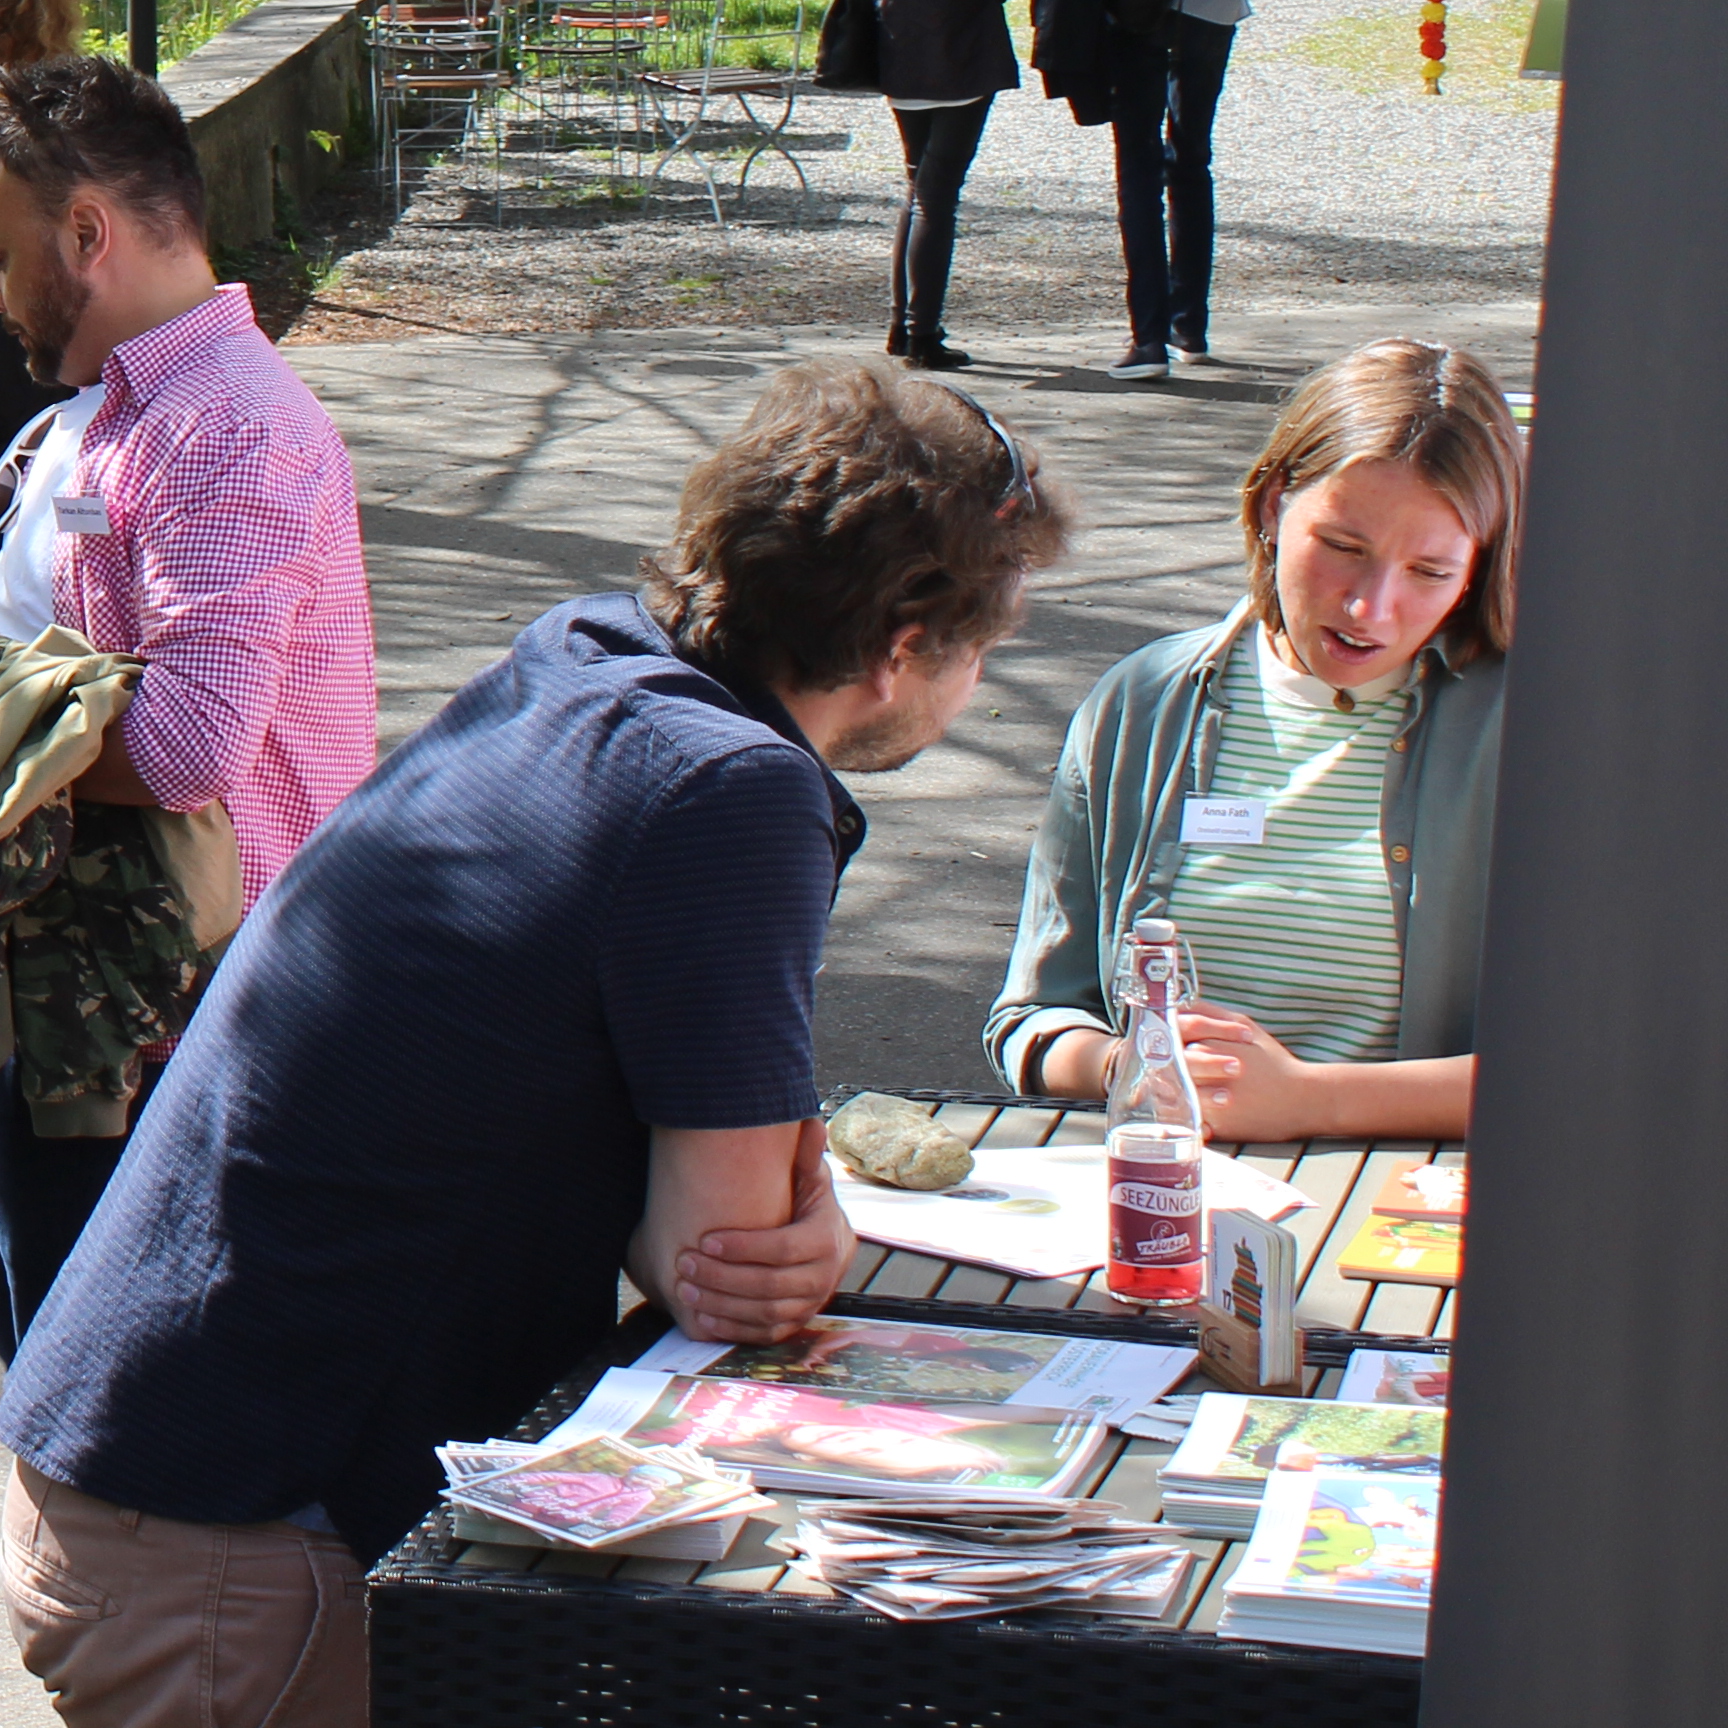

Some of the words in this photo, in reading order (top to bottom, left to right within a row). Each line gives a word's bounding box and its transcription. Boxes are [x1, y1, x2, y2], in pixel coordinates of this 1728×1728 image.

[1202, 807, 1227, 817] Anna
[1228, 807, 1250, 818] Fath
[1120, 1186, 1200, 1212] SEEZÜNGLE
[1222, 1289, 1232, 1311] 17
